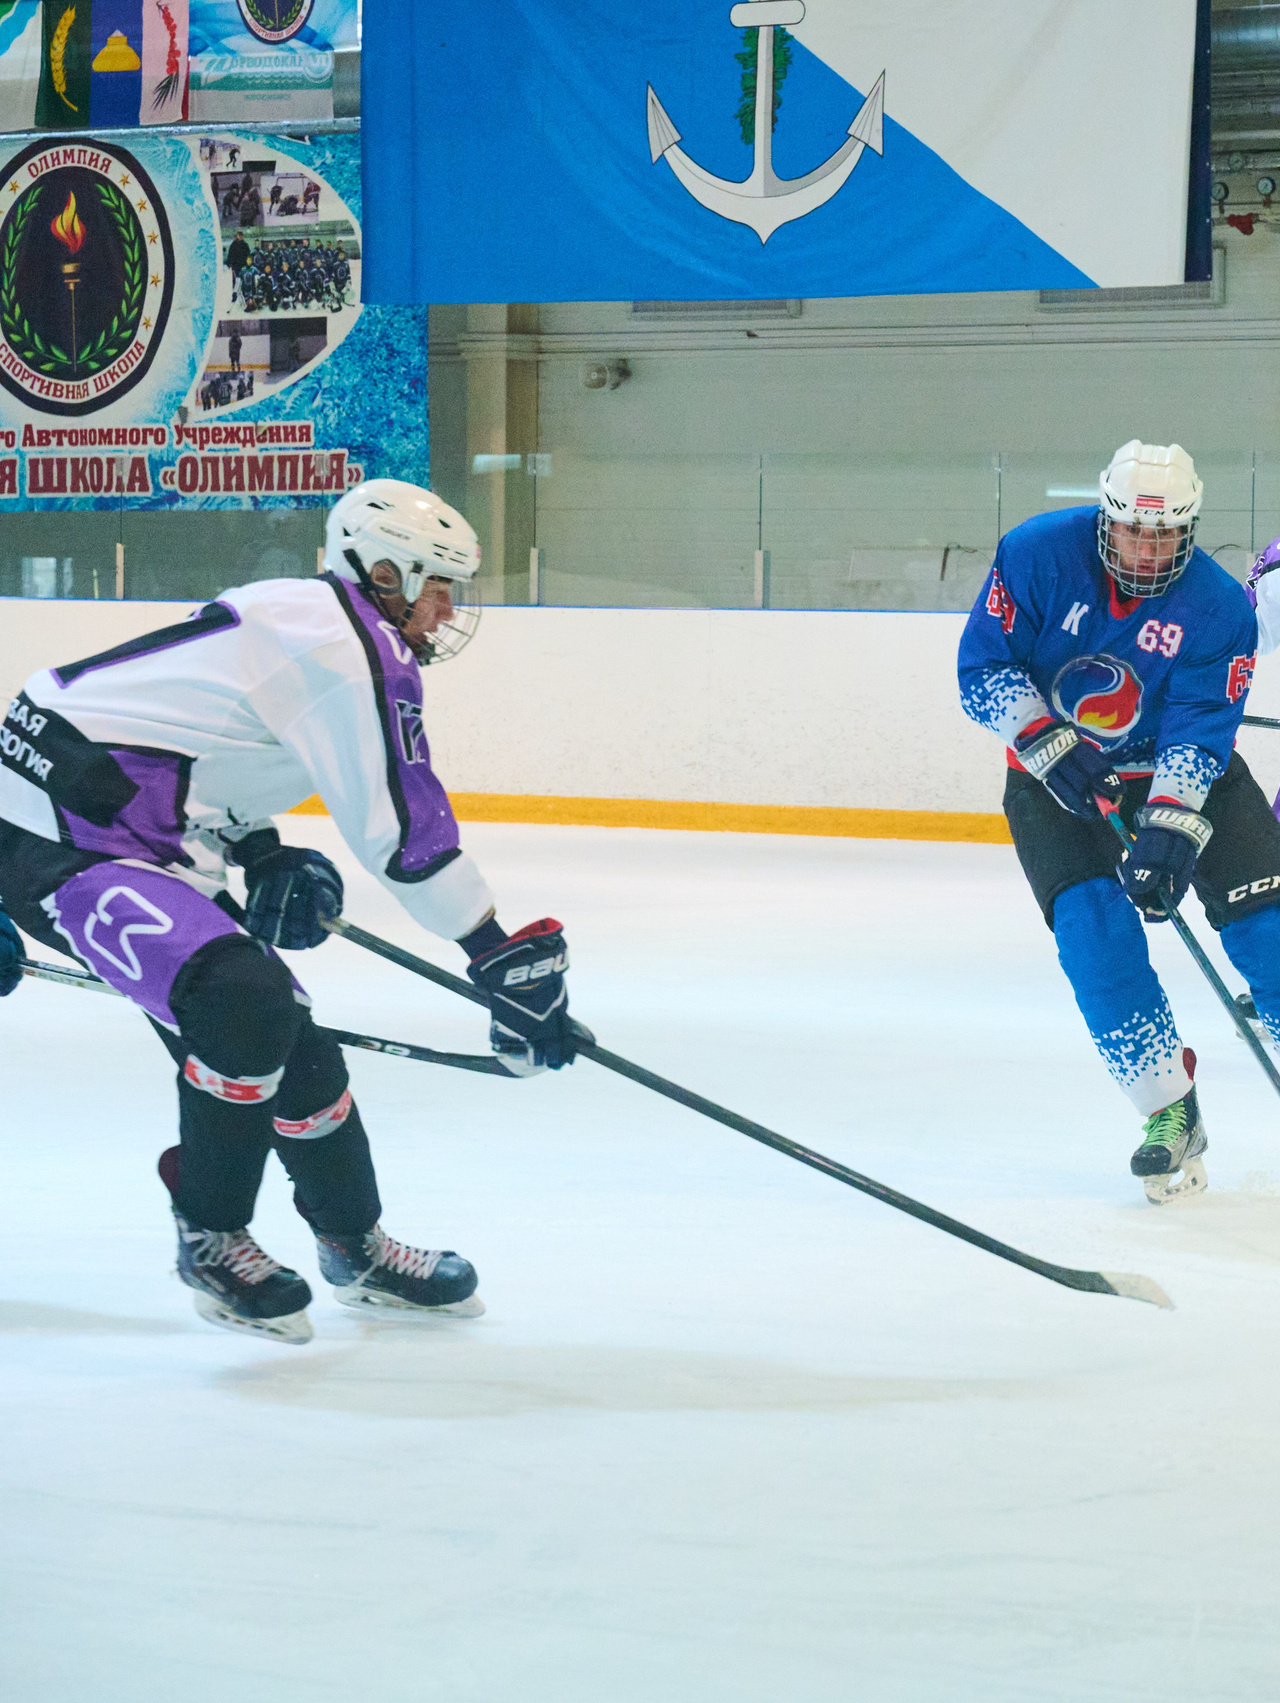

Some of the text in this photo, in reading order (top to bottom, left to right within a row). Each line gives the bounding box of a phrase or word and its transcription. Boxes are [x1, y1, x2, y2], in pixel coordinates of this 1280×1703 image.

[27, 148, 113, 179] ОЛИМПИЯ
[0, 340, 146, 400] СПОРТИВНАЯ ШКОЛА
[22, 424, 166, 447] Автономного
[28, 457, 150, 493] ШКОЛА
[162, 452, 361, 493] «ОЛИМПИЯ»
[1133, 508, 1166, 516] CCM
[1136, 619, 1184, 658] 69
